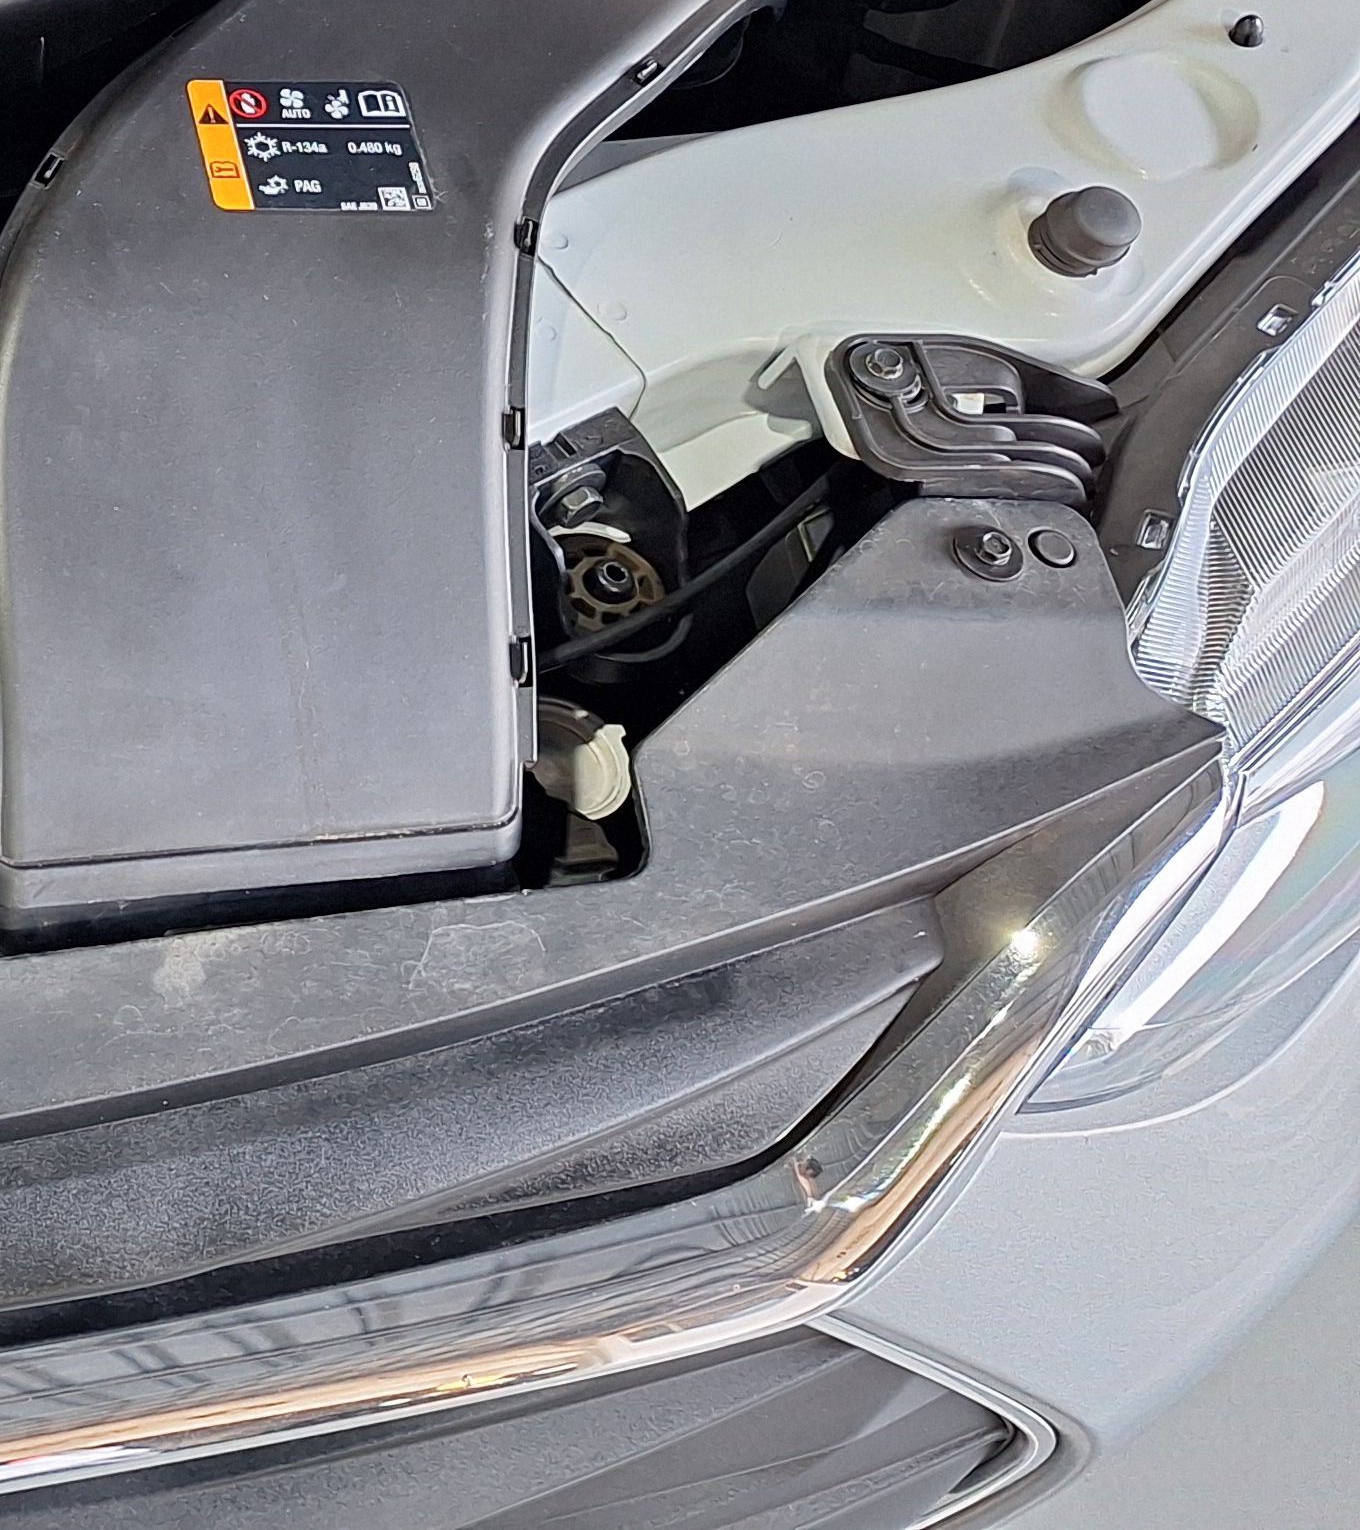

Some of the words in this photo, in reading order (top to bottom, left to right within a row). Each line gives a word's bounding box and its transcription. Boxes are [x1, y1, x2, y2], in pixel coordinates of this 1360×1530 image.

[281, 108, 312, 119] AUTO
[281, 140, 328, 154] R-134a
[384, 141, 403, 156] kg
[293, 179, 322, 193] PAG
